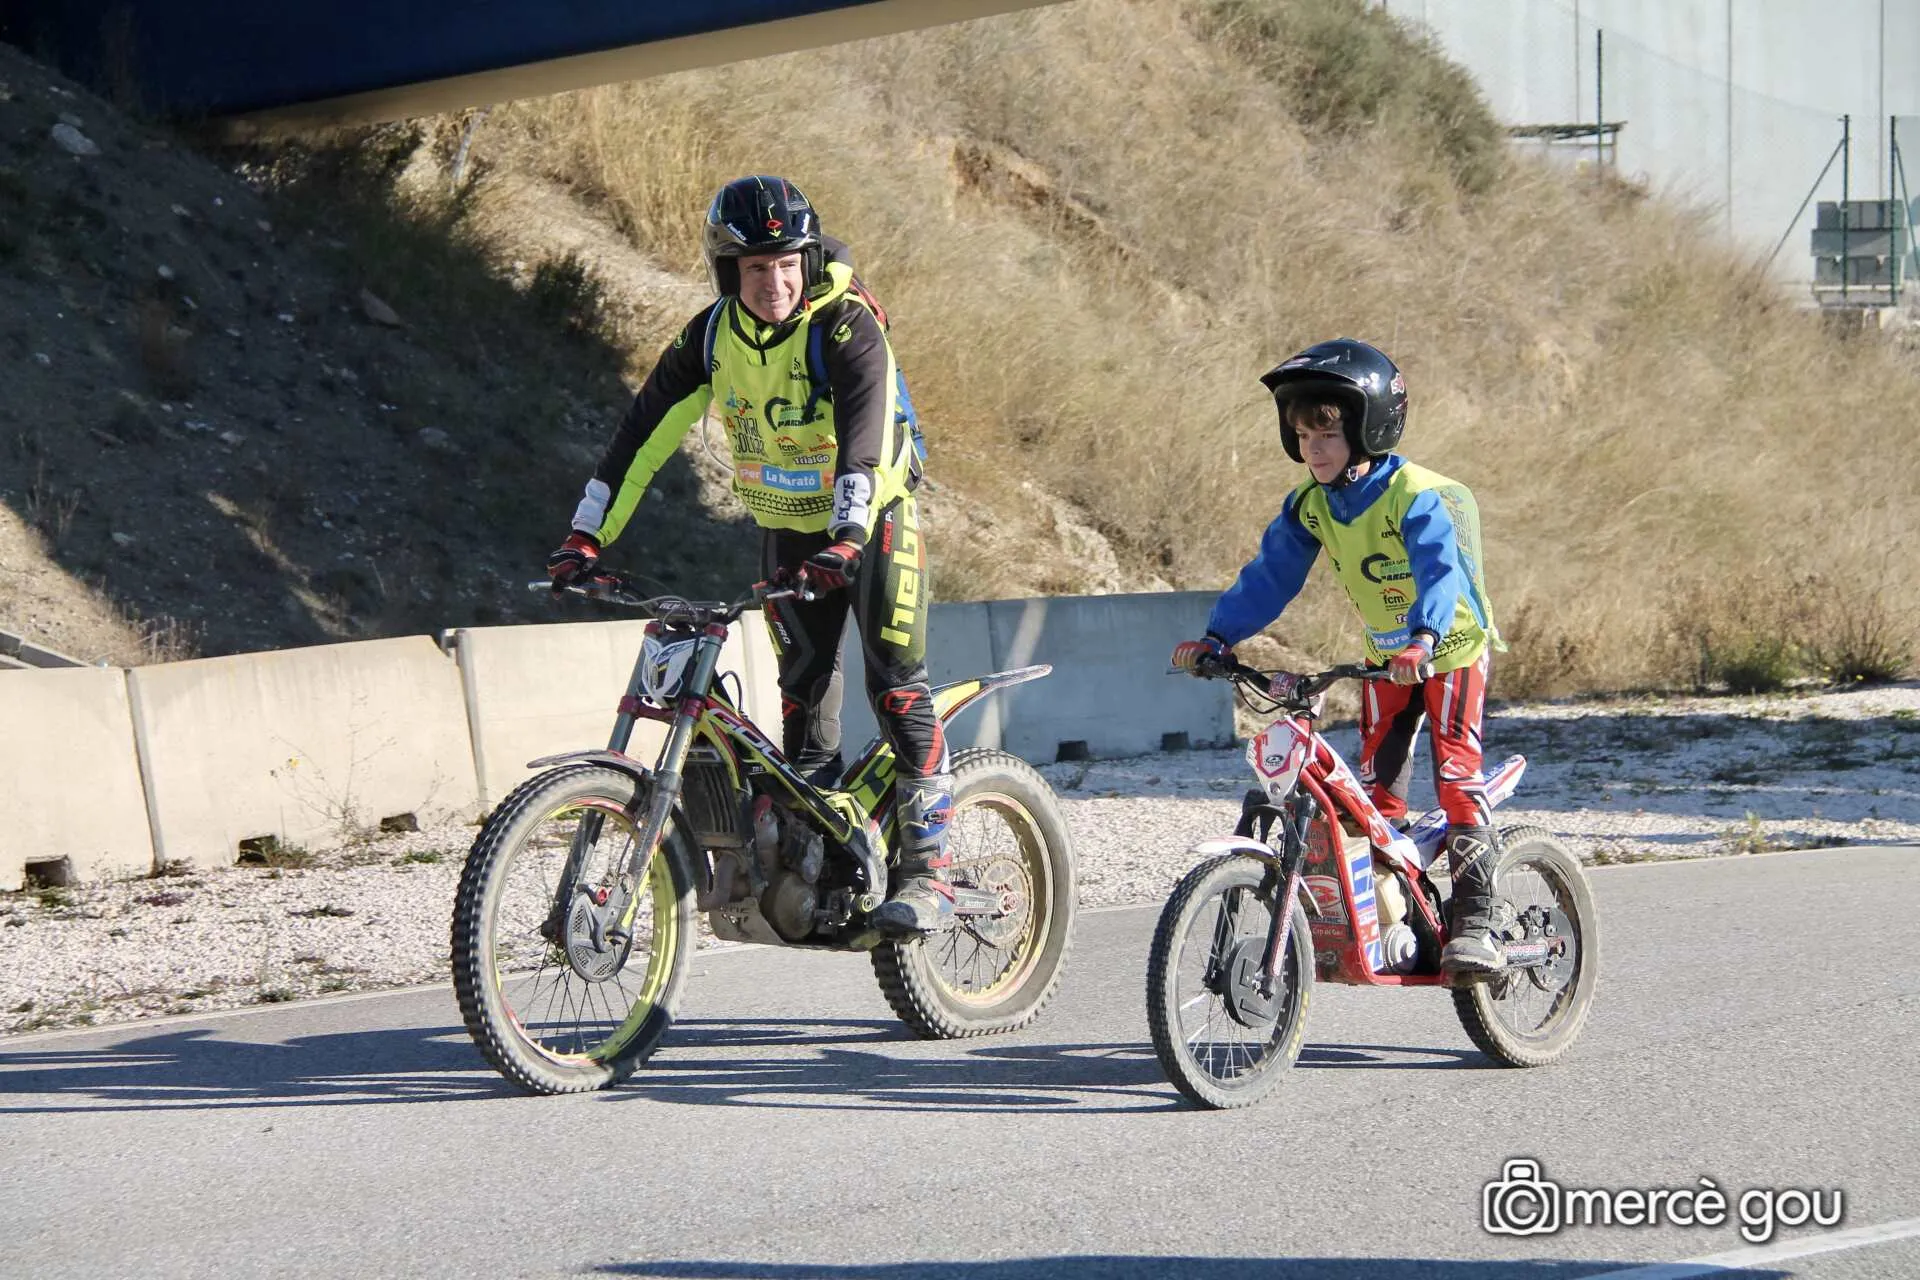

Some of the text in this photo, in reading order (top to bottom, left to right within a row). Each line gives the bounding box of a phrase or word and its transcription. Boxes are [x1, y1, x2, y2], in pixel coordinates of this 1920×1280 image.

[766, 471, 777, 482] La
[779, 472, 816, 486] Marató
[1383, 594, 1405, 604] fcm
